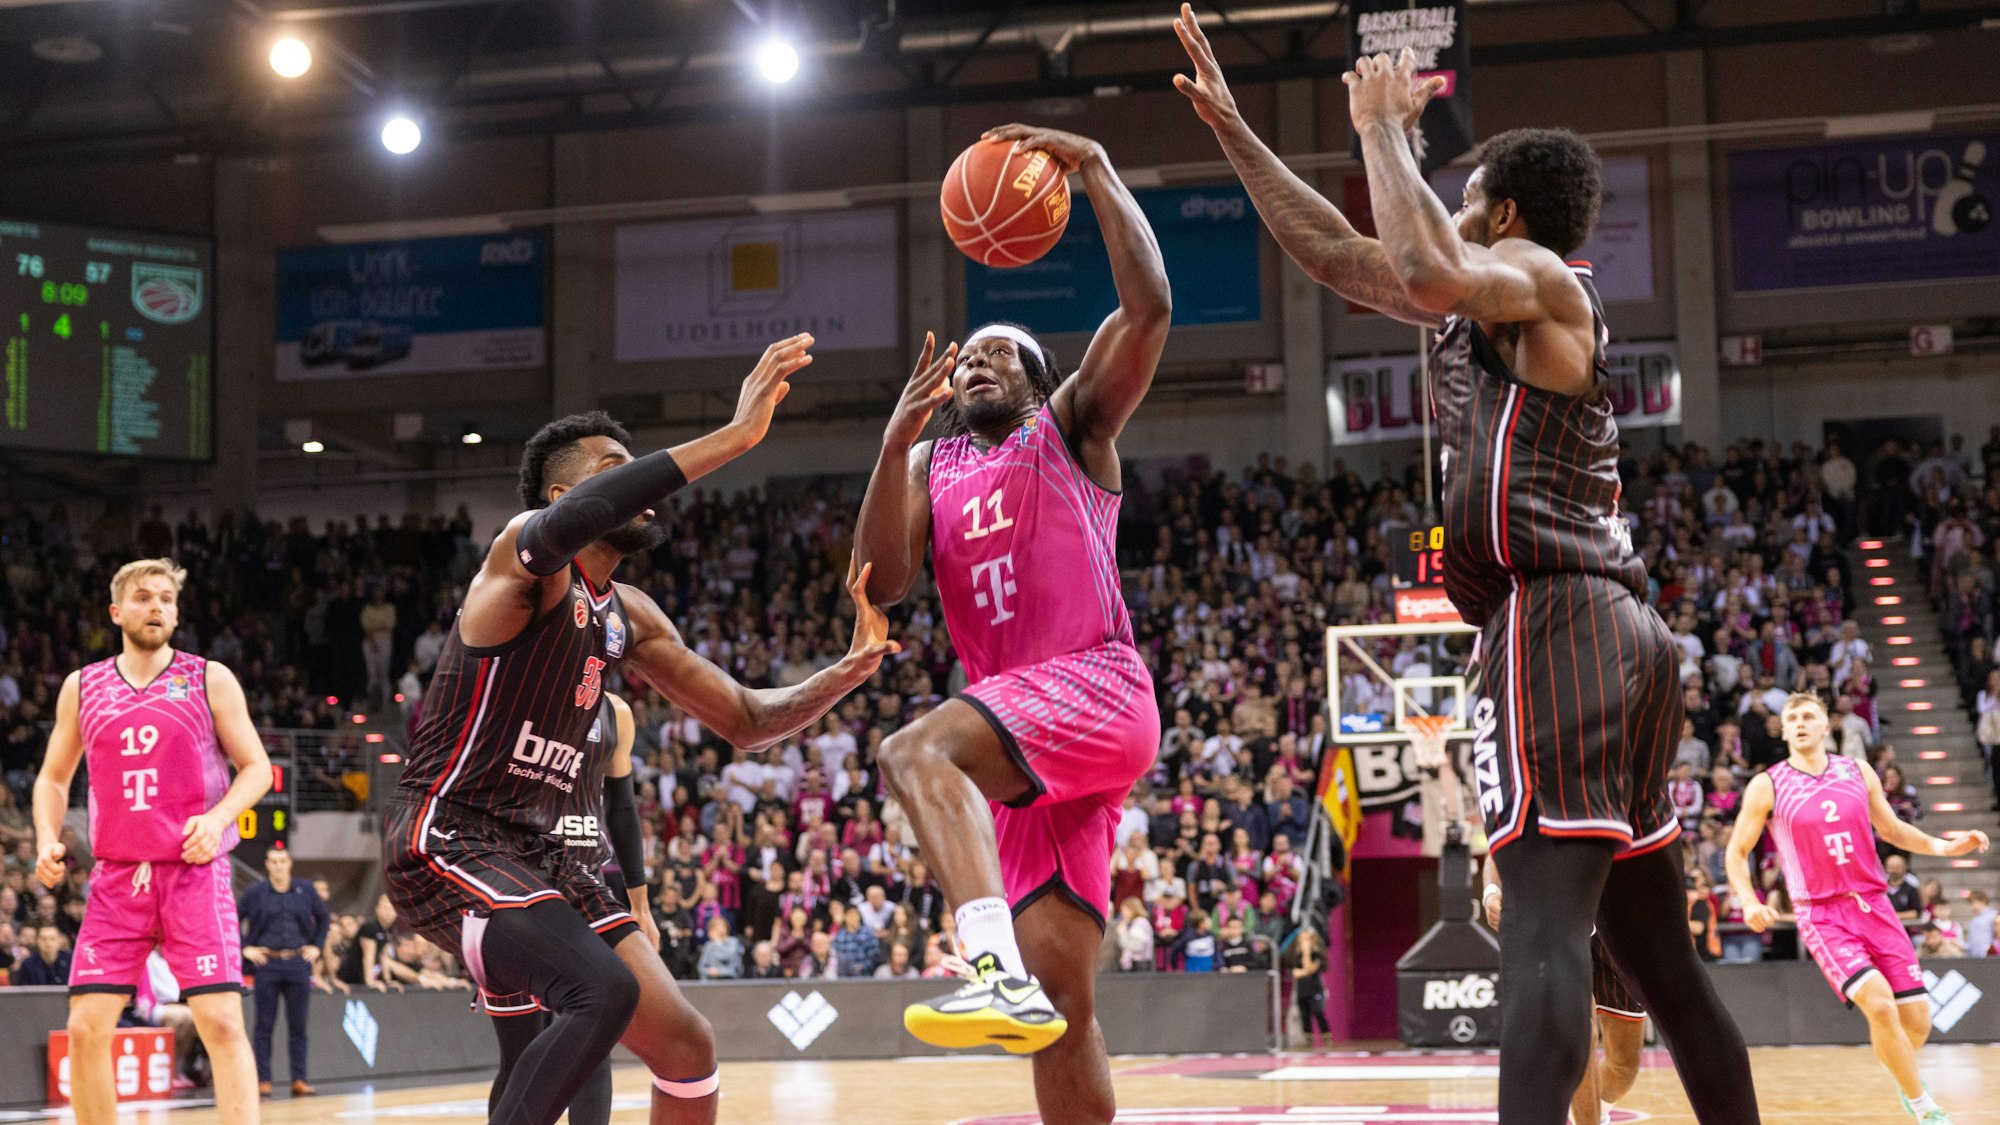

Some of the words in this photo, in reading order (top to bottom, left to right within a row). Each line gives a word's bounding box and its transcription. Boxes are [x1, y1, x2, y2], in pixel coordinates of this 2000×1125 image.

[1180, 196, 1245, 221] dhpg
[1801, 204, 1911, 230] BOWLING
[1740, 338, 1761, 361] H
[1913, 328, 1933, 351] G
[1247, 367, 1267, 388] H
[962, 488, 1014, 540] 11
[970, 551, 1018, 626] T
[575, 656, 607, 710] 35
[120, 724, 159, 756] 19
[122, 768, 158, 811] T
[1820, 800, 1840, 823] 2
[1823, 831, 1854, 866] T
[1422, 974, 1496, 1010] RKG
